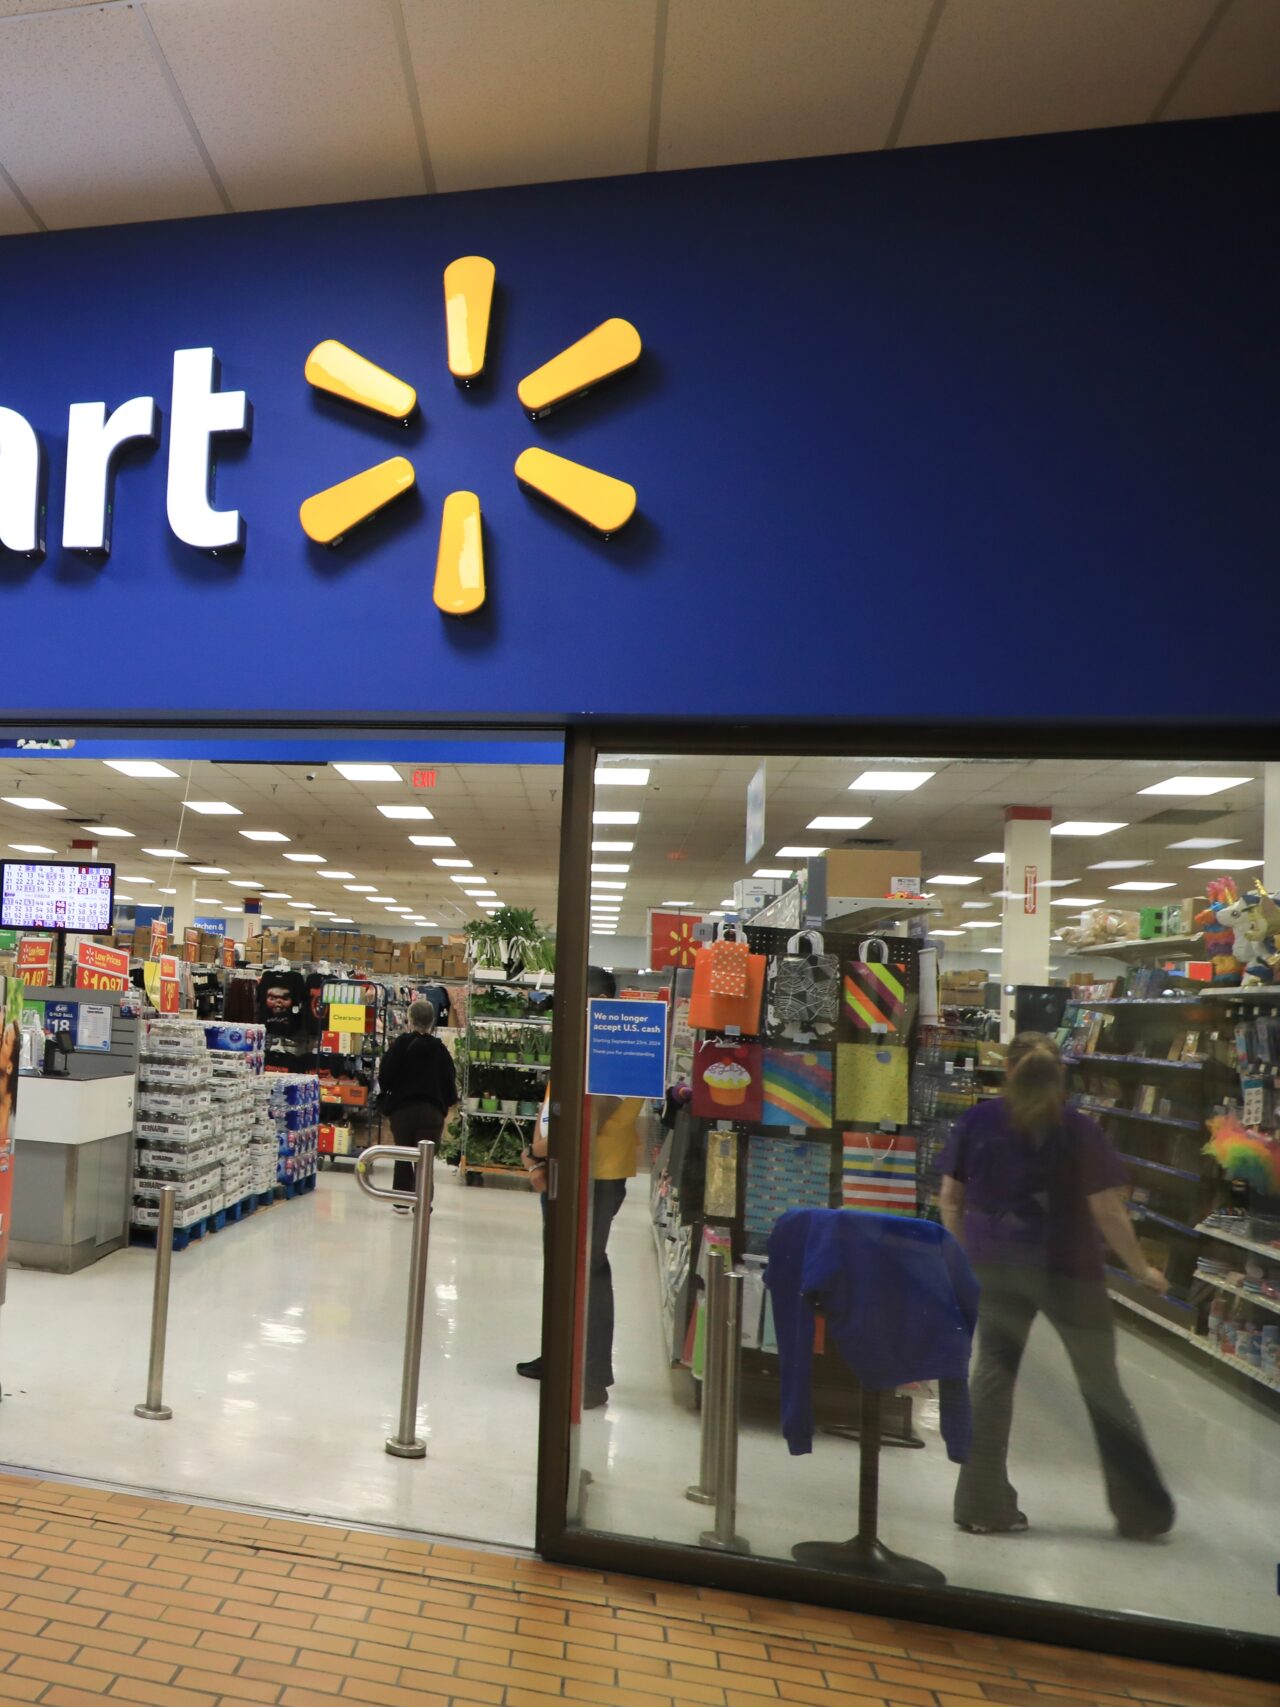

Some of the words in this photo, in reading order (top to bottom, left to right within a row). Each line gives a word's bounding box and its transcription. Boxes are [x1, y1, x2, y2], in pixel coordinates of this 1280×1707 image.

[413, 770, 437, 788] EXIT
[95, 951, 106, 961] Low
[106, 953, 121, 966] Prices
[333, 1014, 362, 1022] Clearance
[621, 1014, 648, 1024] longer
[593, 1024, 621, 1032] accept
